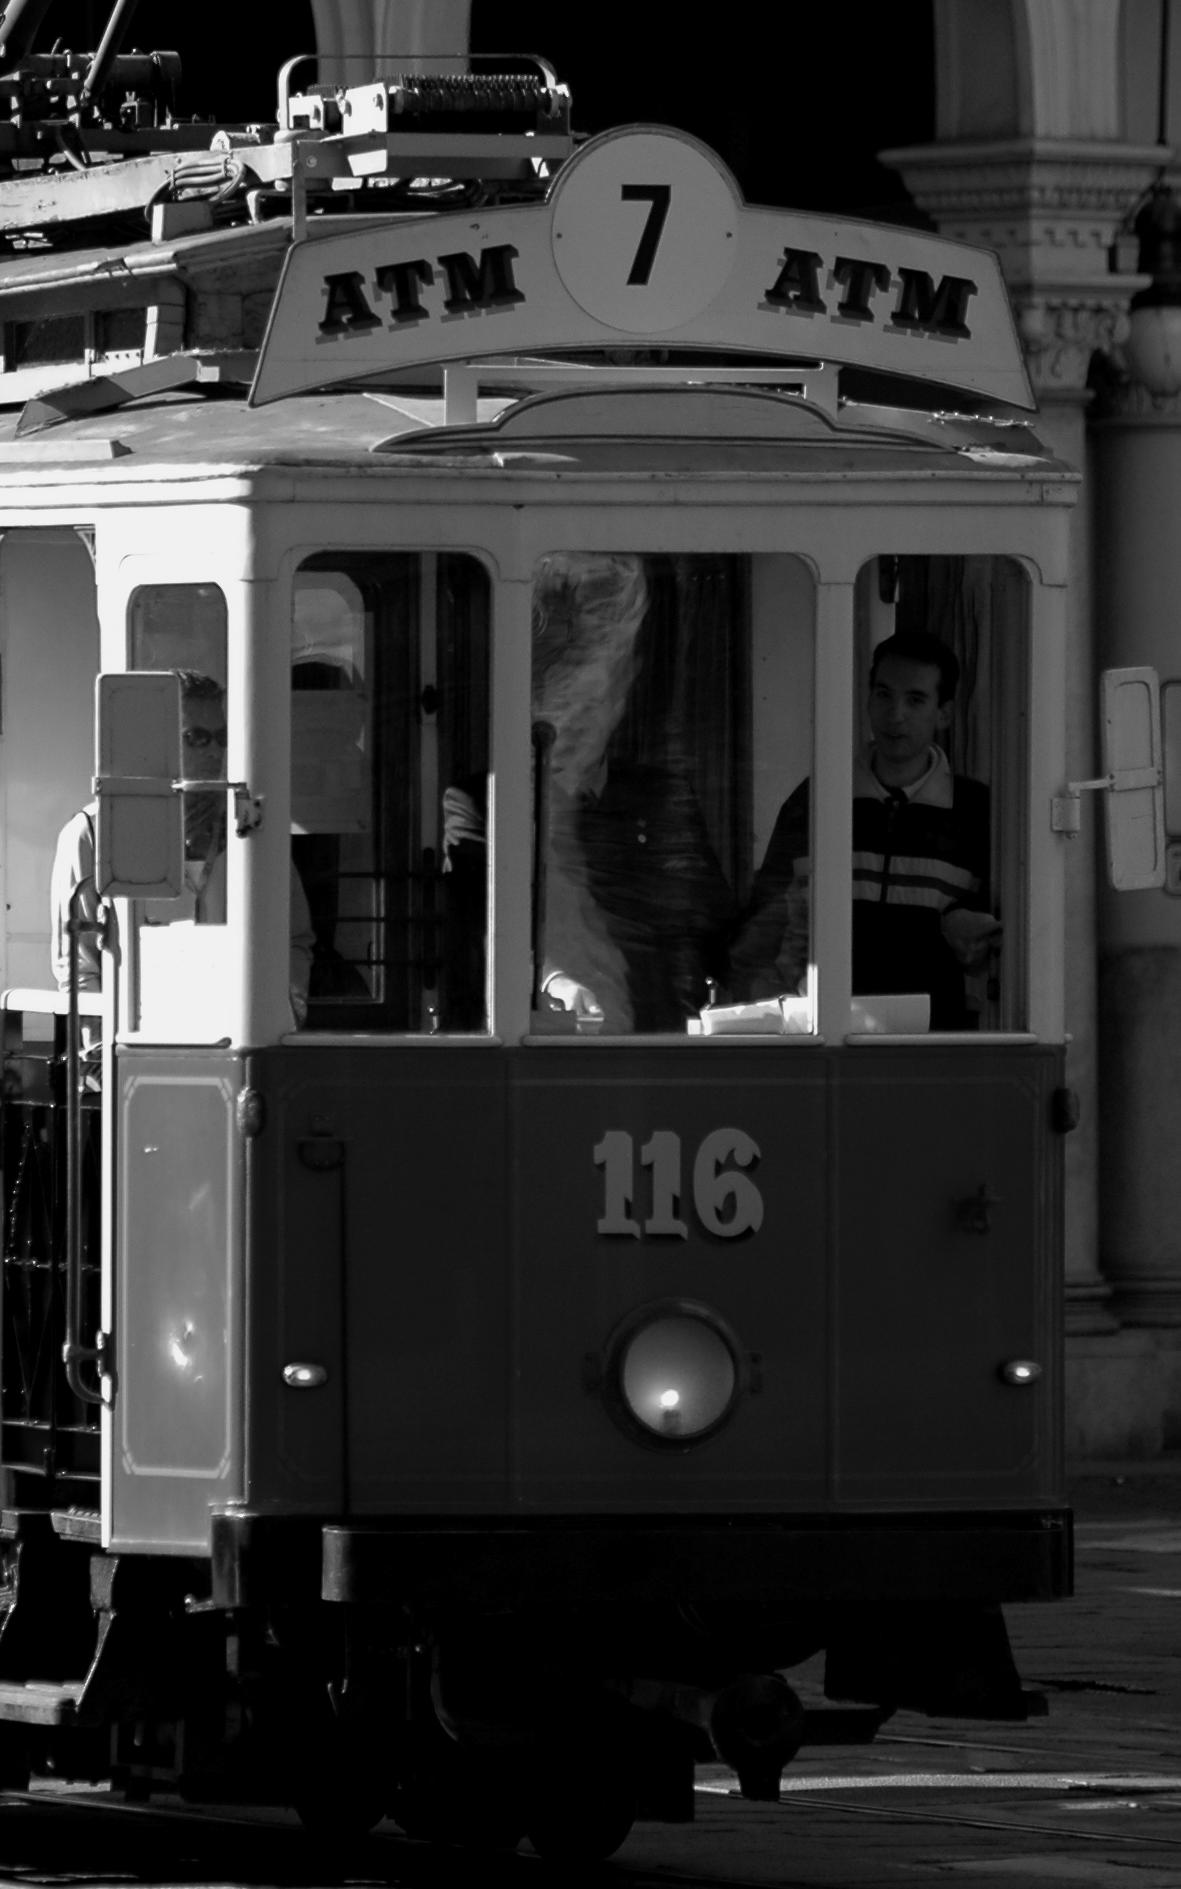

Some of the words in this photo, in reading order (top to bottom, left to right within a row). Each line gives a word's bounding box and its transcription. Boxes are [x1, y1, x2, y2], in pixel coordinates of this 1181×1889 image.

[315, 243, 525, 343] ATM
[620, 183, 672, 287] 7
[757, 246, 980, 341] ATM
[593, 1127, 765, 1243] 116
